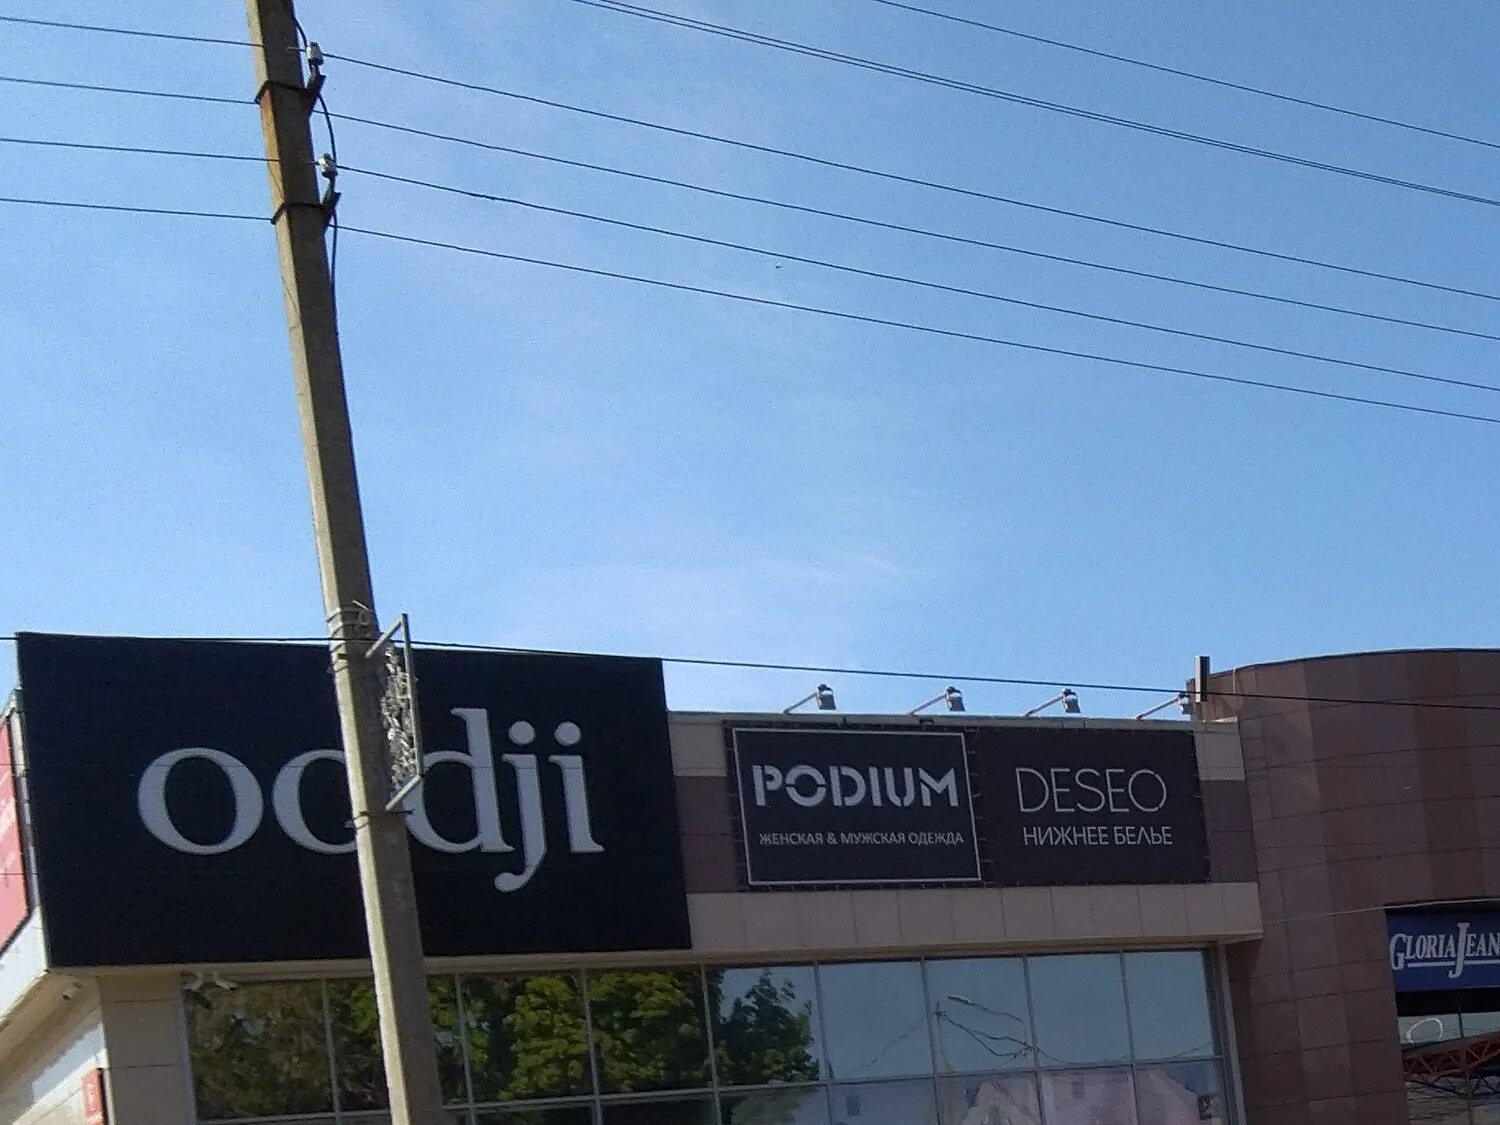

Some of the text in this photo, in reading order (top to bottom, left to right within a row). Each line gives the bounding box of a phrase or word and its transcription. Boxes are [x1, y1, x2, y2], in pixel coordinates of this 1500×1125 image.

[137, 707, 605, 893] oodji
[752, 765, 959, 807] PODIUM
[1015, 767, 1168, 813] DESEO
[759, 831, 965, 846] ЖЕНСКАЯ & МУЖСКАЯ ОДЕЖДА
[1022, 825, 1174, 846] НИЖНЕЕ БЕЛЬЕ
